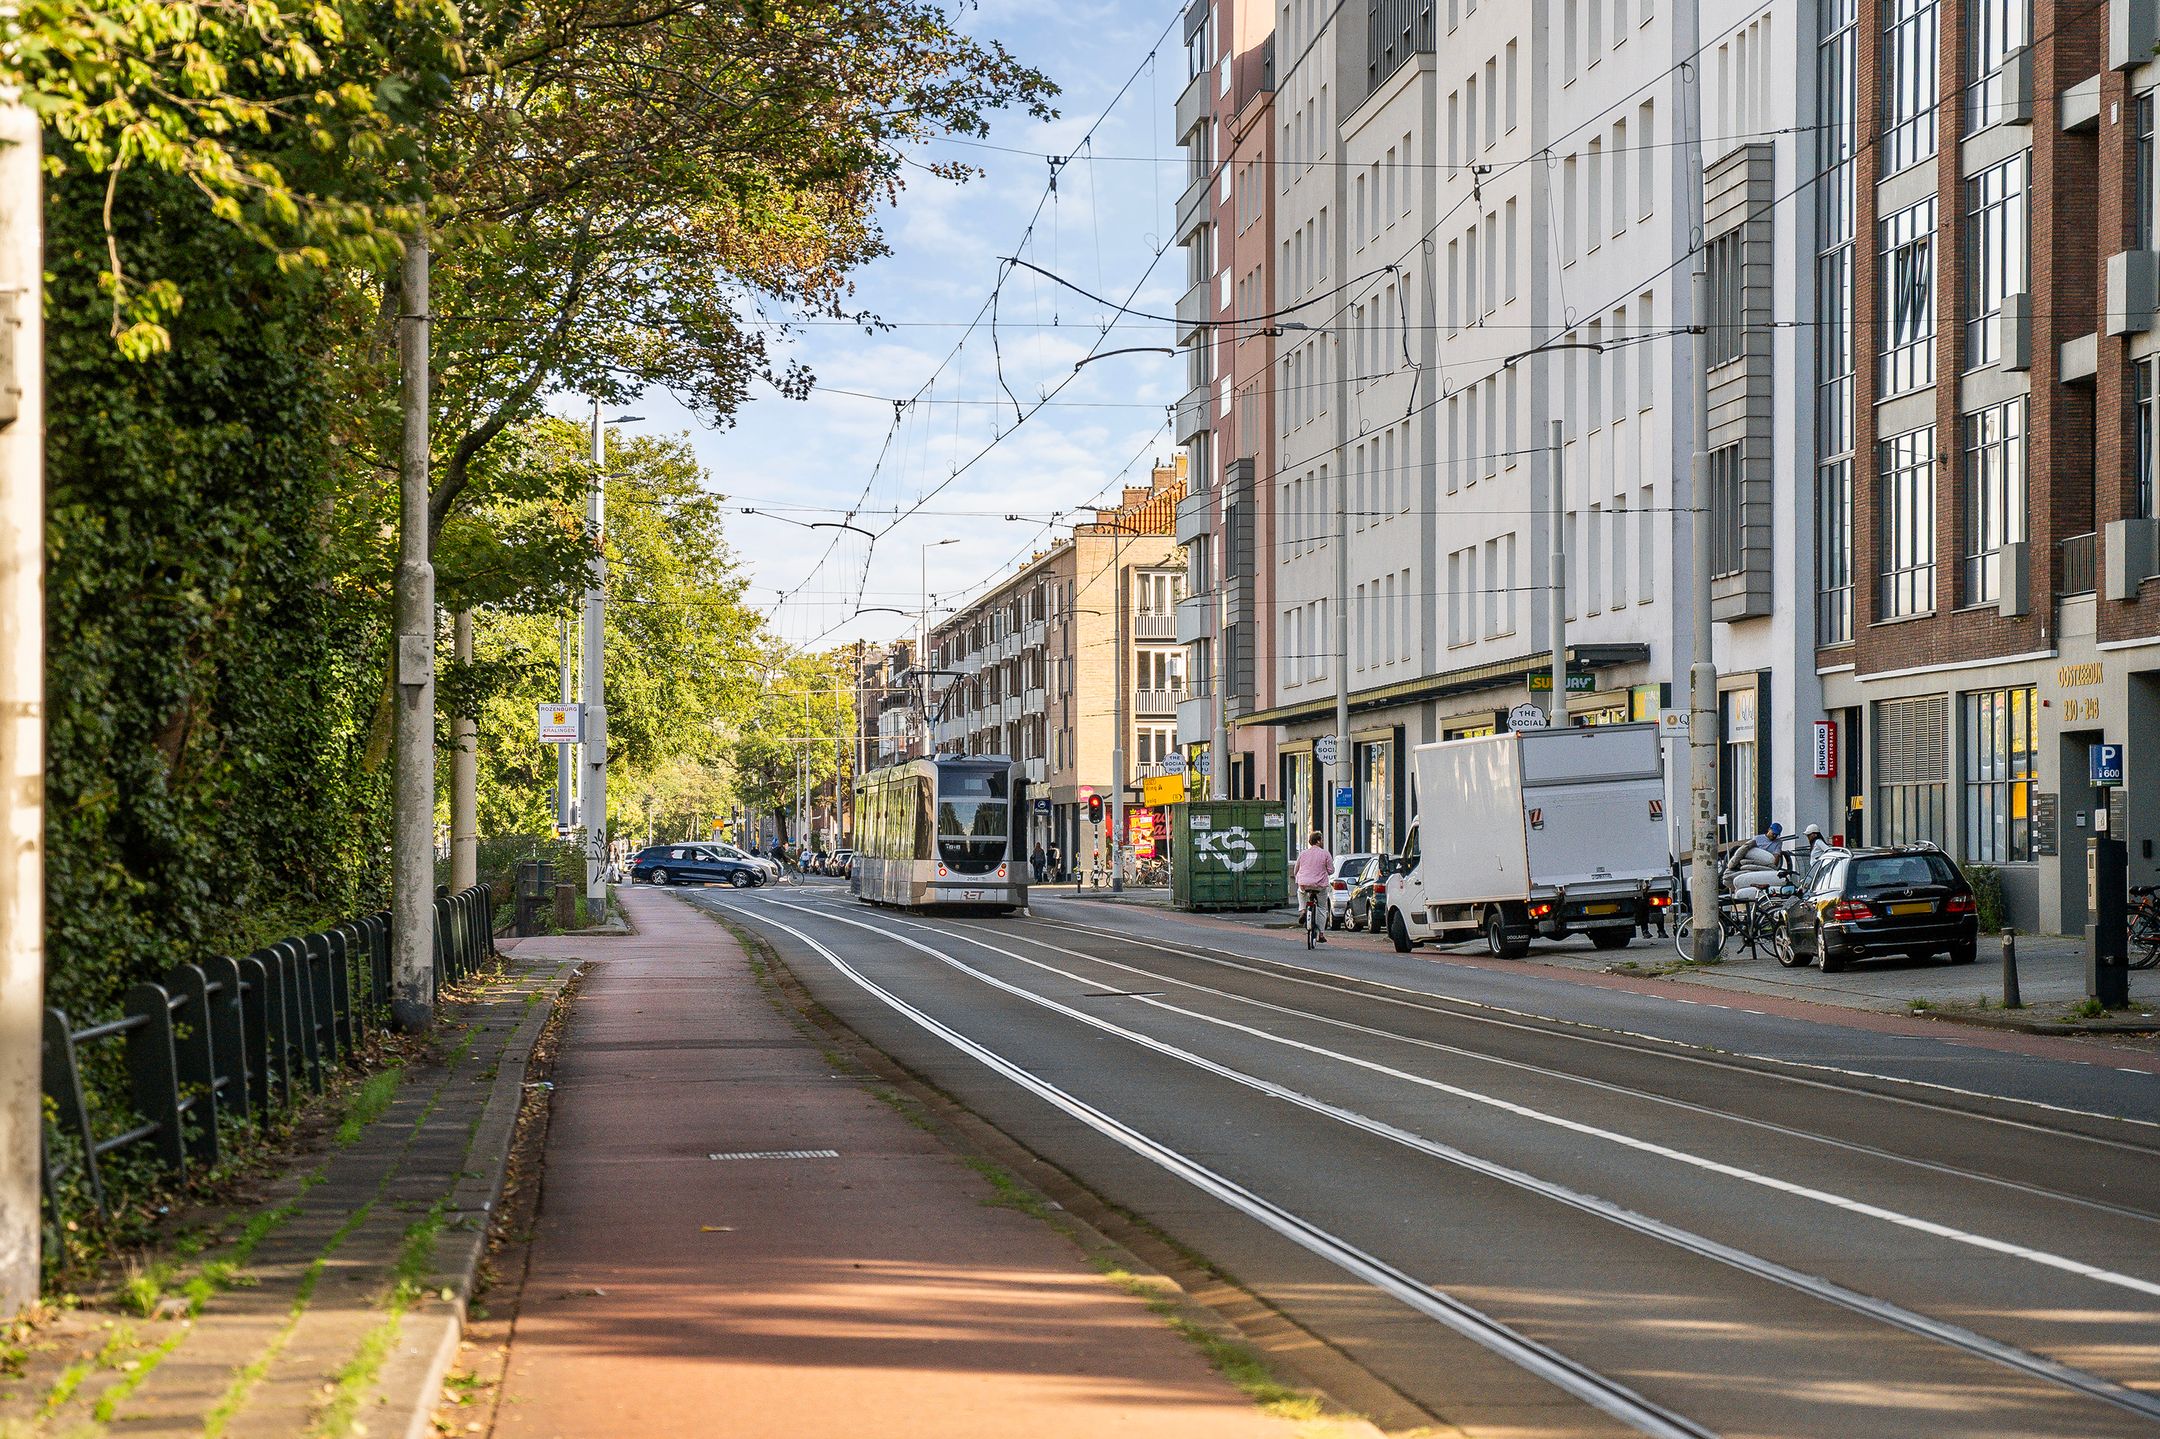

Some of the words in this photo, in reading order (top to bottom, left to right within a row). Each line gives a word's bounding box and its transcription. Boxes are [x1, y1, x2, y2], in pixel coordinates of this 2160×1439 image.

[1532, 677, 1592, 689] SUAY
[1511, 719, 1544, 727] SOCIAL
[2101, 746, 2116, 767] P
[2103, 769, 2120, 778] 600
[1336, 788, 1343, 798] P
[963, 891, 984, 900] RET
